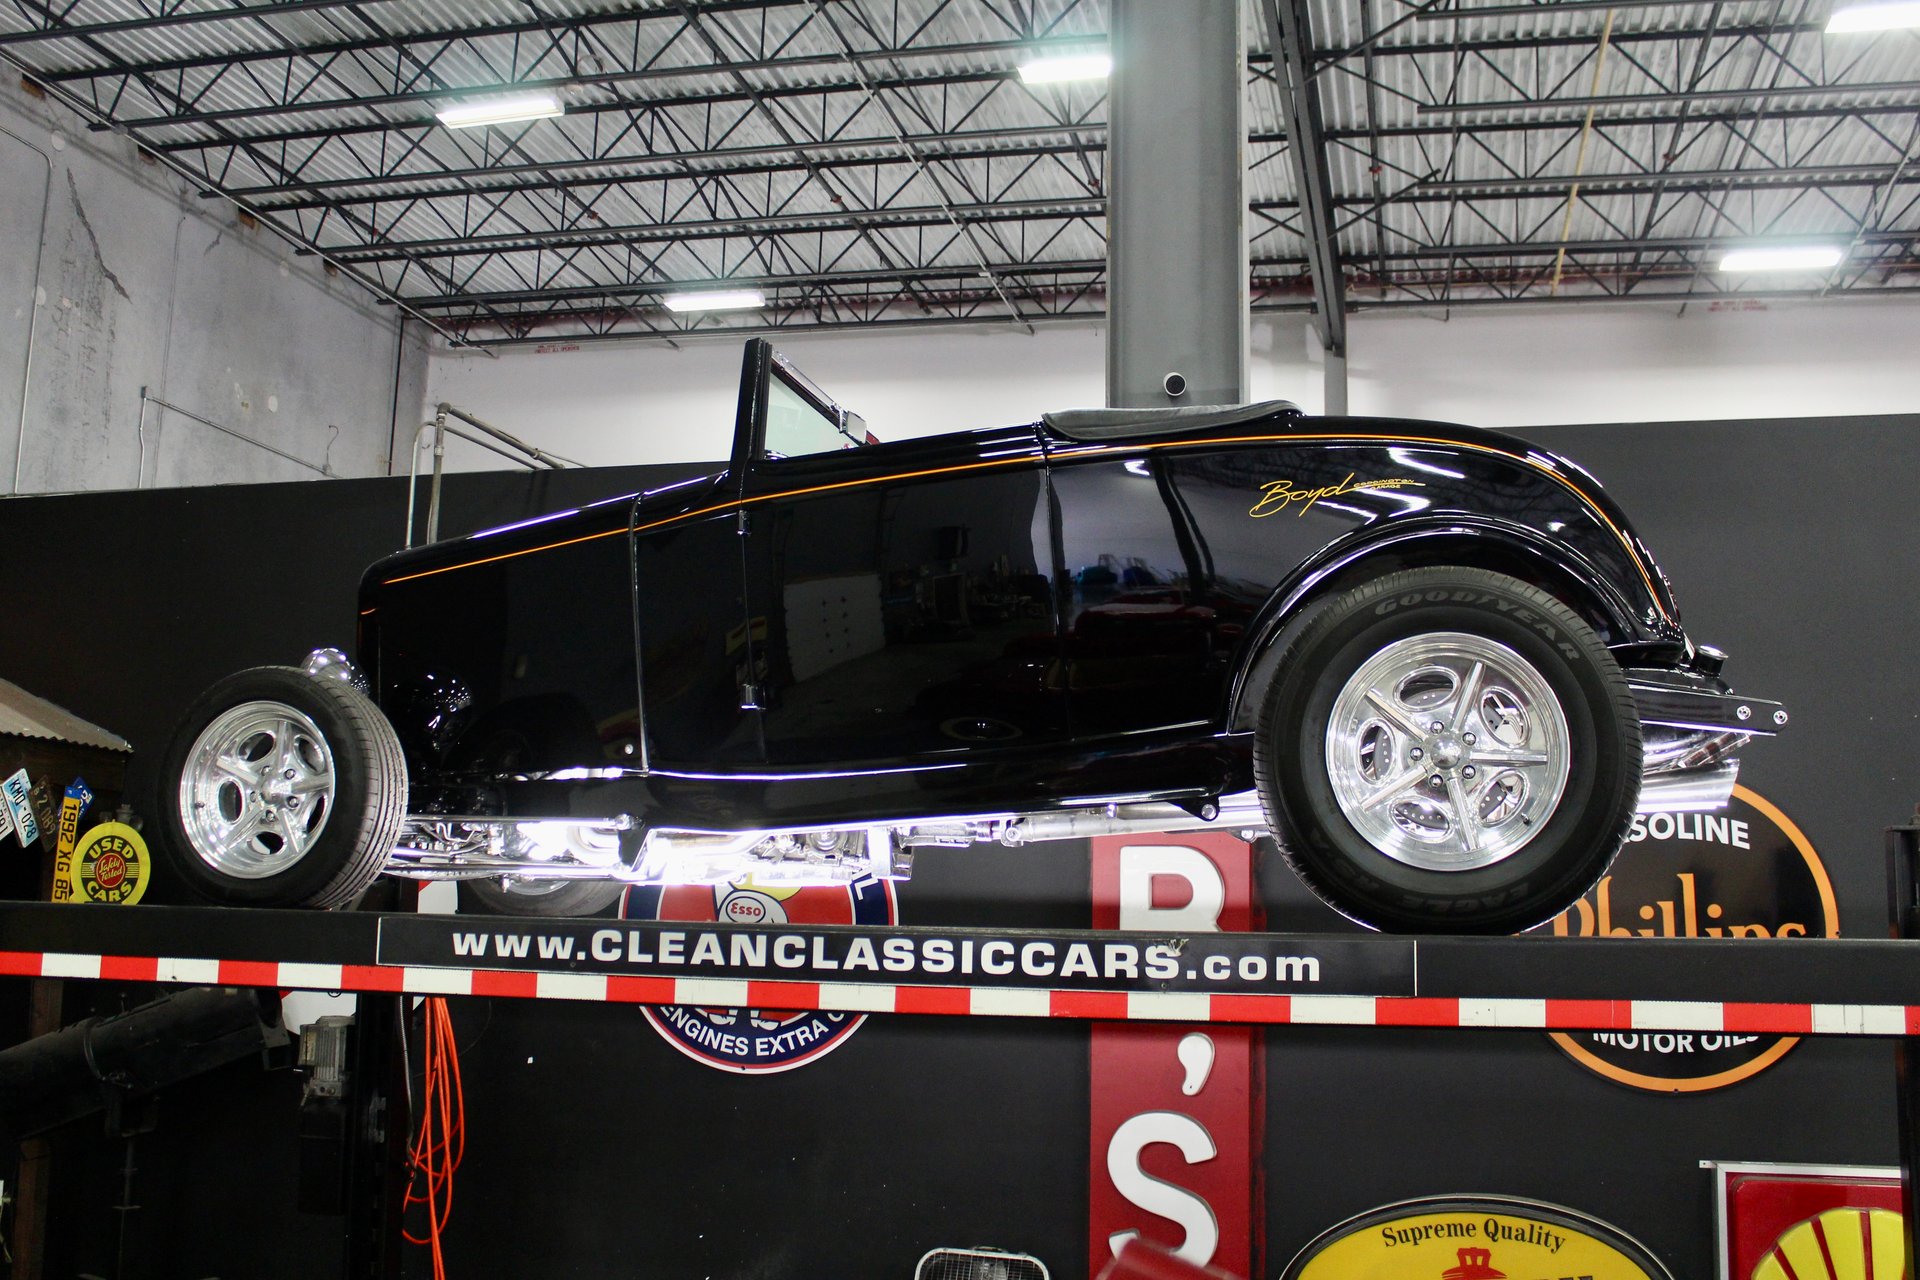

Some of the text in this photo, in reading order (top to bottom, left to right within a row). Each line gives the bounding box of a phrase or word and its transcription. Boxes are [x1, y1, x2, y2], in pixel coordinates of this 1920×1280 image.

[1249, 472, 1355, 518] Boyd
[1375, 590, 1580, 660] GOODYEAR
[60, 804, 77, 843] 1992
[1622, 812, 1751, 850] SOLINE
[57, 850, 71, 872] XG
[88, 838, 134, 859] USED
[99, 857, 121, 873] Safety
[87, 881, 132, 902] CARS
[452, 929, 1321, 982] www.CLEANCLASSICCARS.com
[660, 1006, 829, 1057] ENGINES EXTRA
[1381, 1218, 1566, 1253] Supreme Quality
